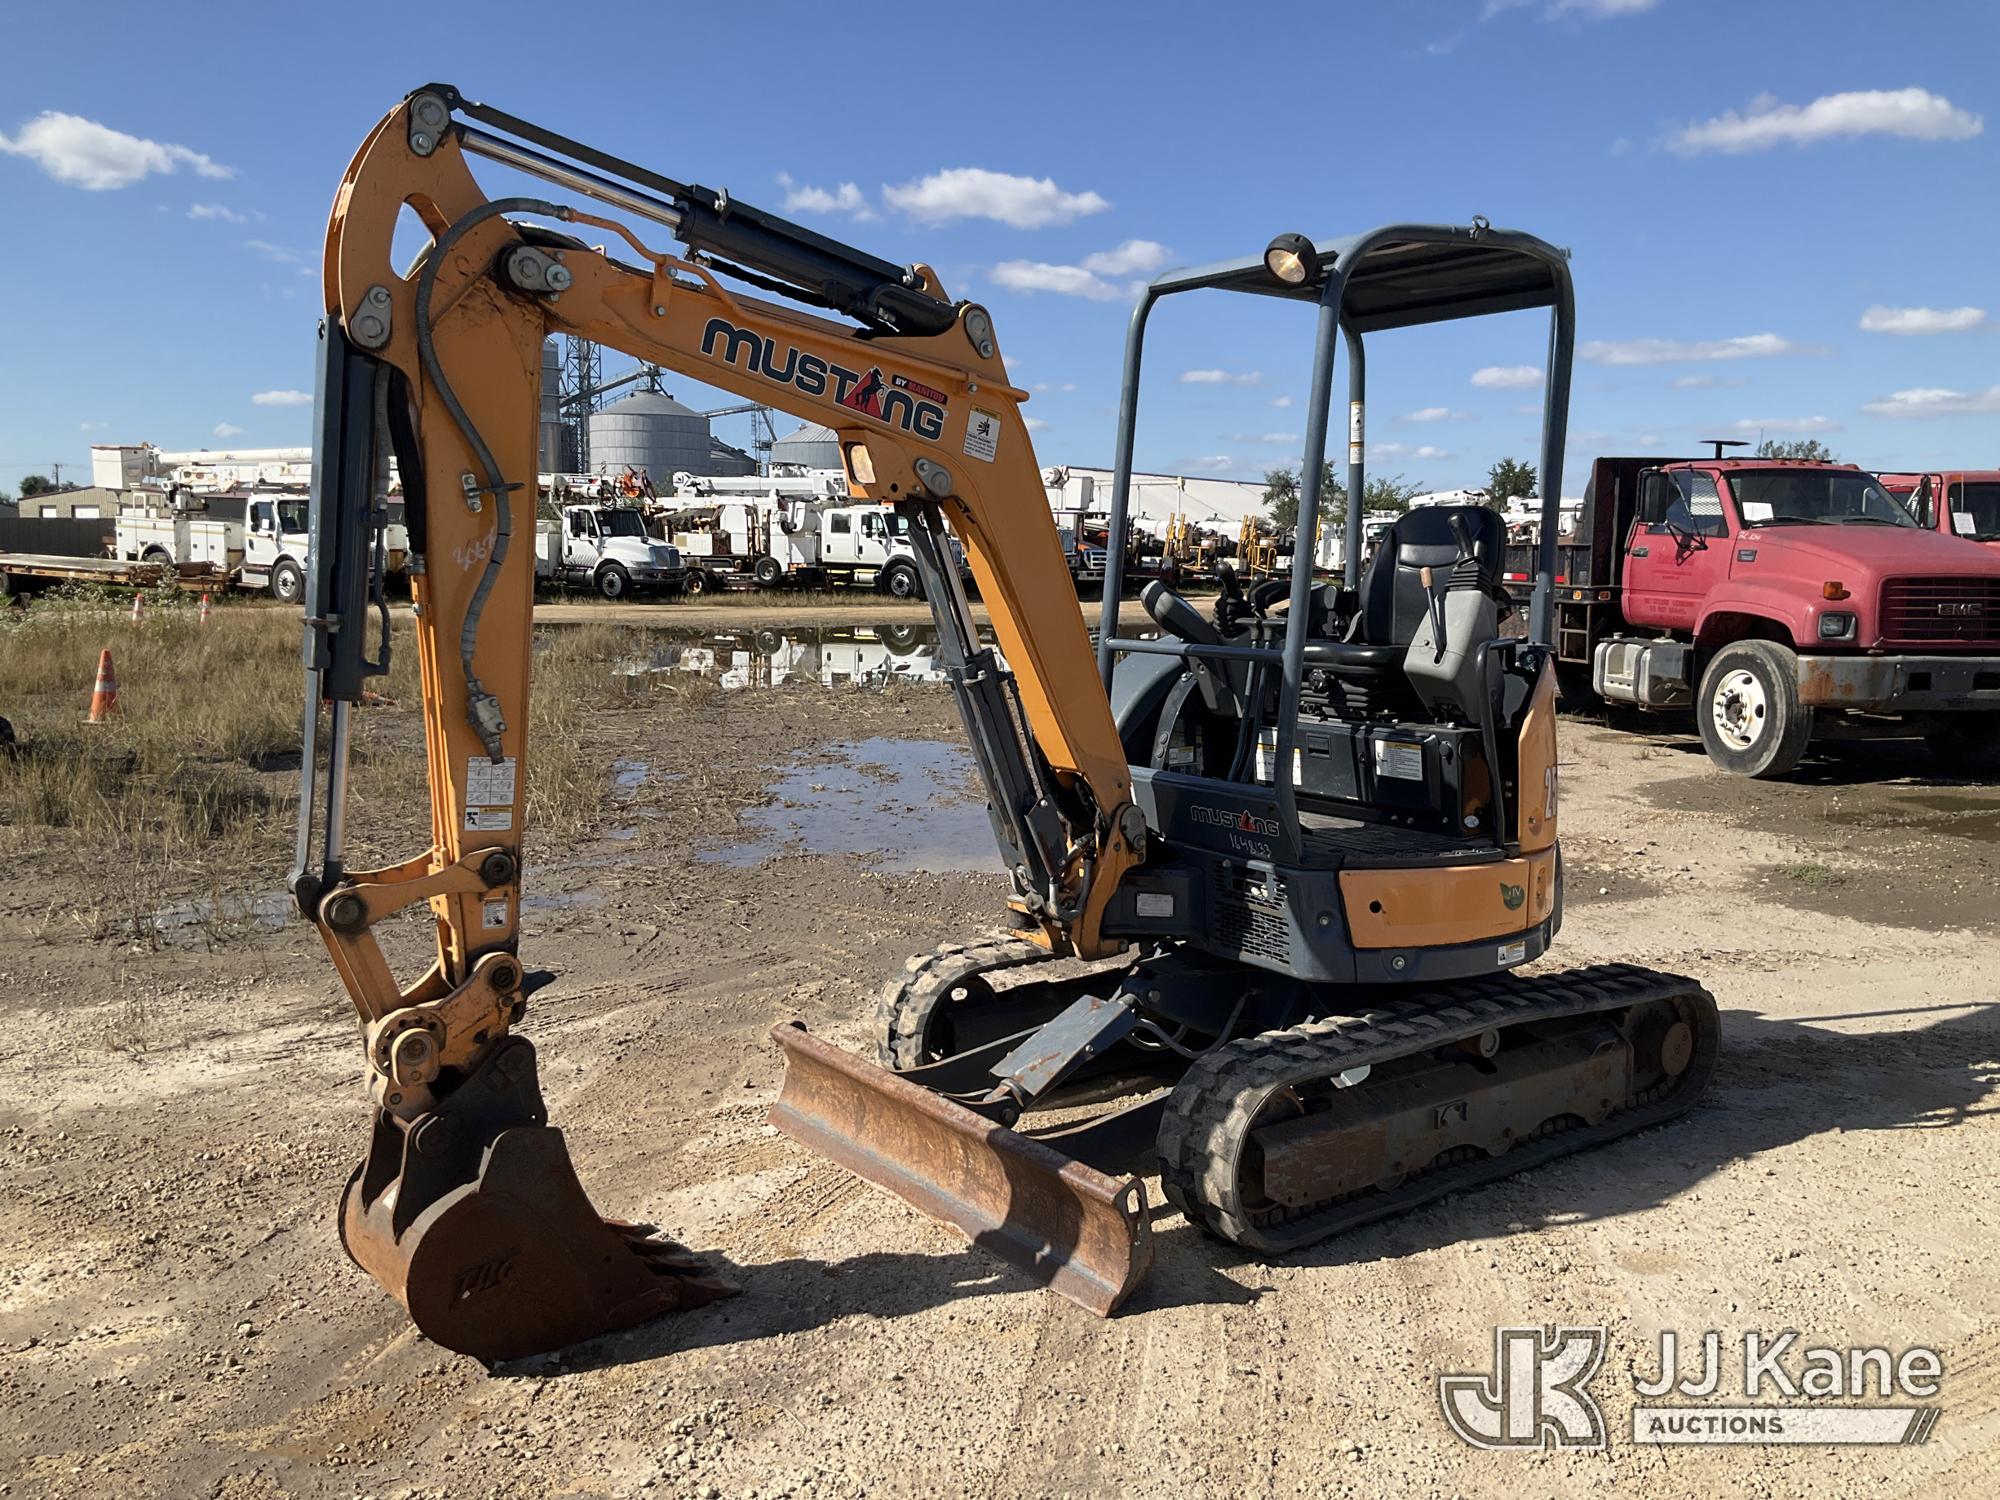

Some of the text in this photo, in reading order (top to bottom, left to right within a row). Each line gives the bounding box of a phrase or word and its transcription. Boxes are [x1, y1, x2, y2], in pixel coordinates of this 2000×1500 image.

[700, 317, 945, 441] MUSTANG
[895, 377, 945, 402] BY MANITOU
[1938, 603, 1982, 615] GMC
[1190, 805, 1279, 836] MUSTANG
